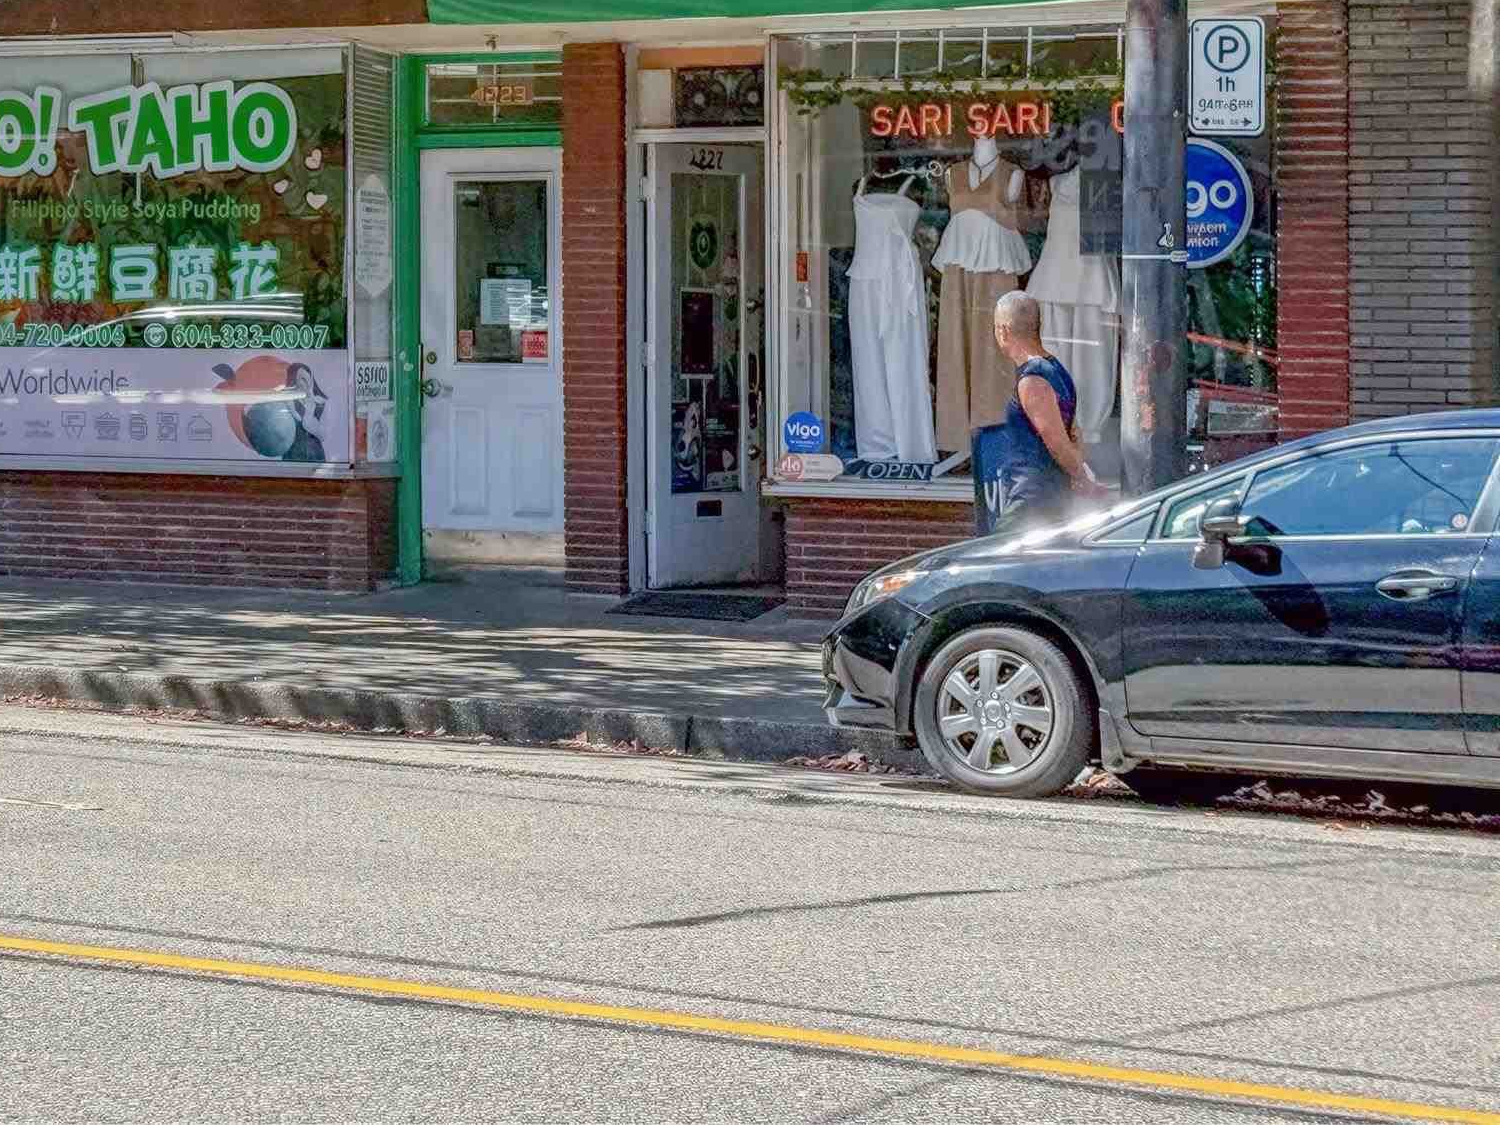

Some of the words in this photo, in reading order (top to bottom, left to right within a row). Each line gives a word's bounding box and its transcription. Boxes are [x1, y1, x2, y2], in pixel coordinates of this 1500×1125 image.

[1218, 35, 1239, 64] P
[1215, 76, 1236, 93] 1h
[69, 81, 297, 178] TAHO
[870, 103, 952, 137] SARI
[966, 101, 1051, 137] SARI
[133, 199, 179, 224] Soya
[181, 198, 261, 224] Pudding
[1186, 179, 1237, 218] go
[867, 462, 931, 481] OPEN
